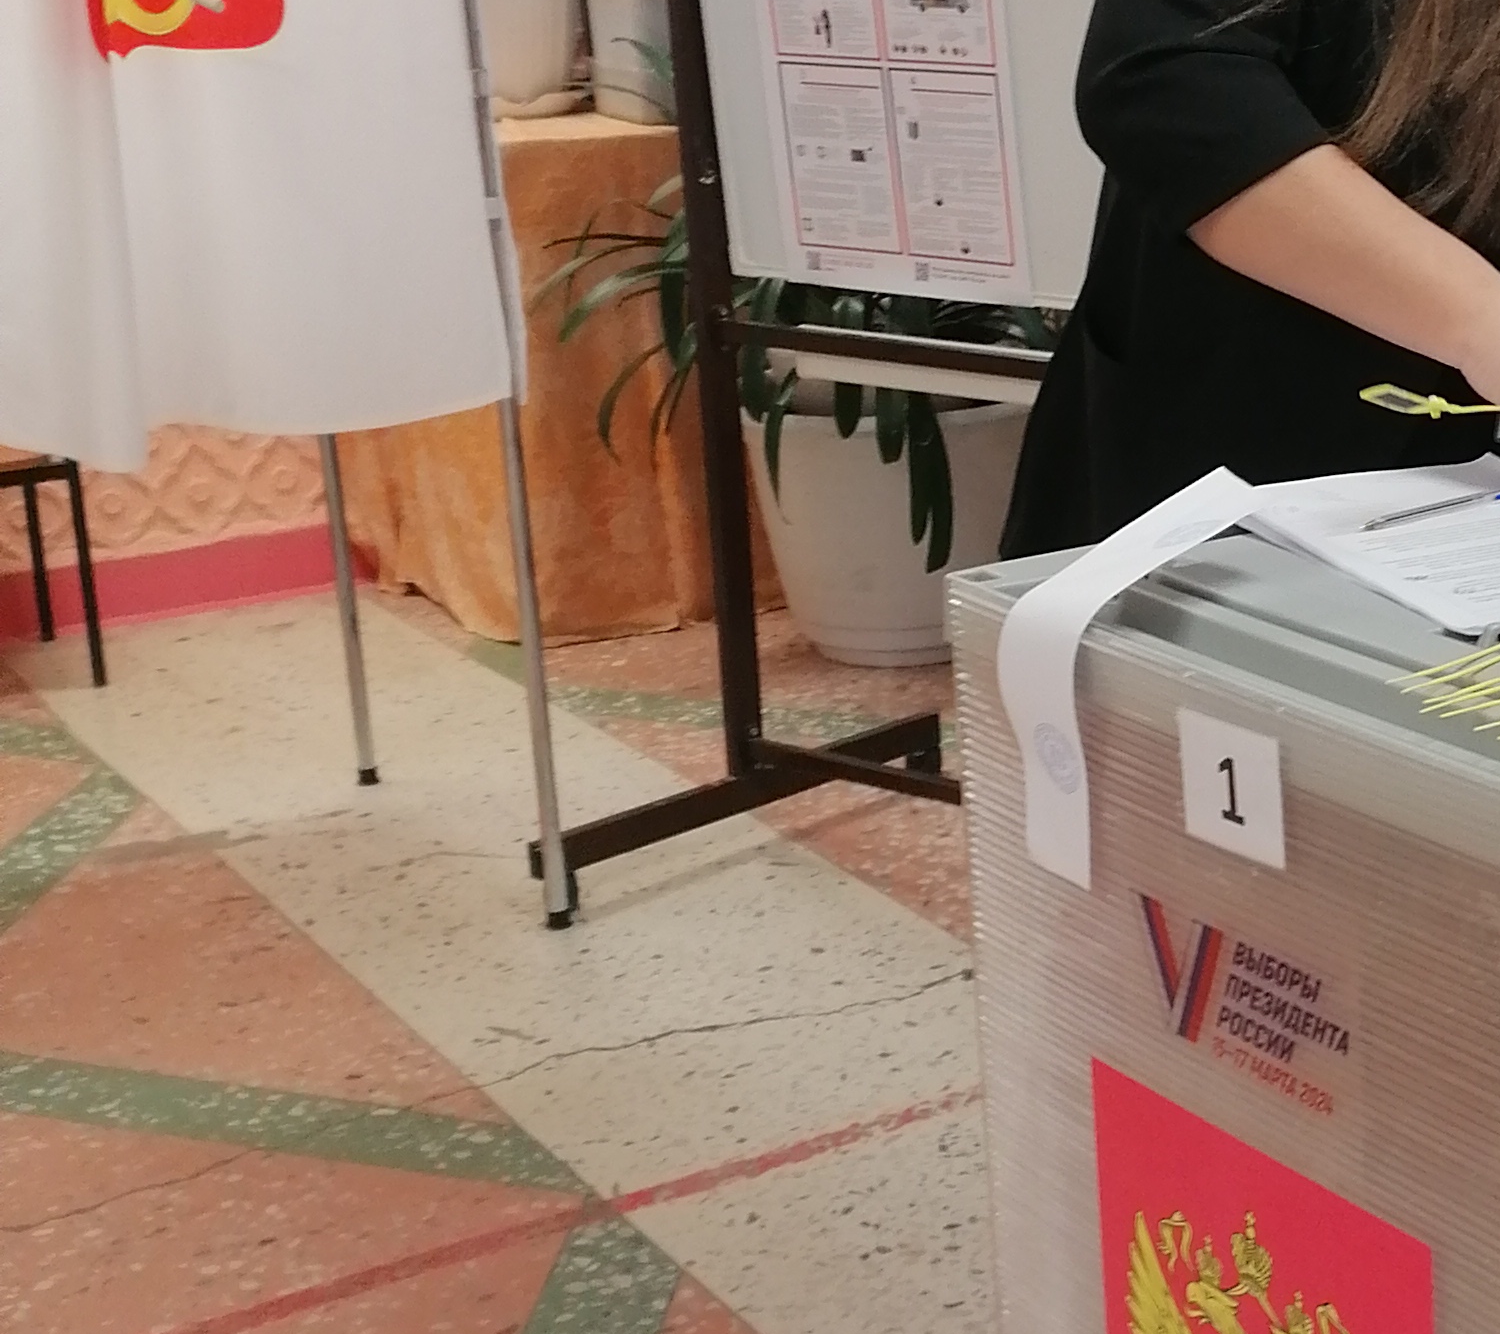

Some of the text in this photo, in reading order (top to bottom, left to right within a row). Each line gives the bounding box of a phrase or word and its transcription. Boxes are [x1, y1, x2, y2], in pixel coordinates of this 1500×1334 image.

[1218, 757, 1246, 827] 1
[1233, 941, 1322, 1004] ВЫБОРЫ
[1216, 1005, 1297, 1063] РОССИИ
[1224, 973, 1351, 1056] ПРЕЗИДЕНТА
